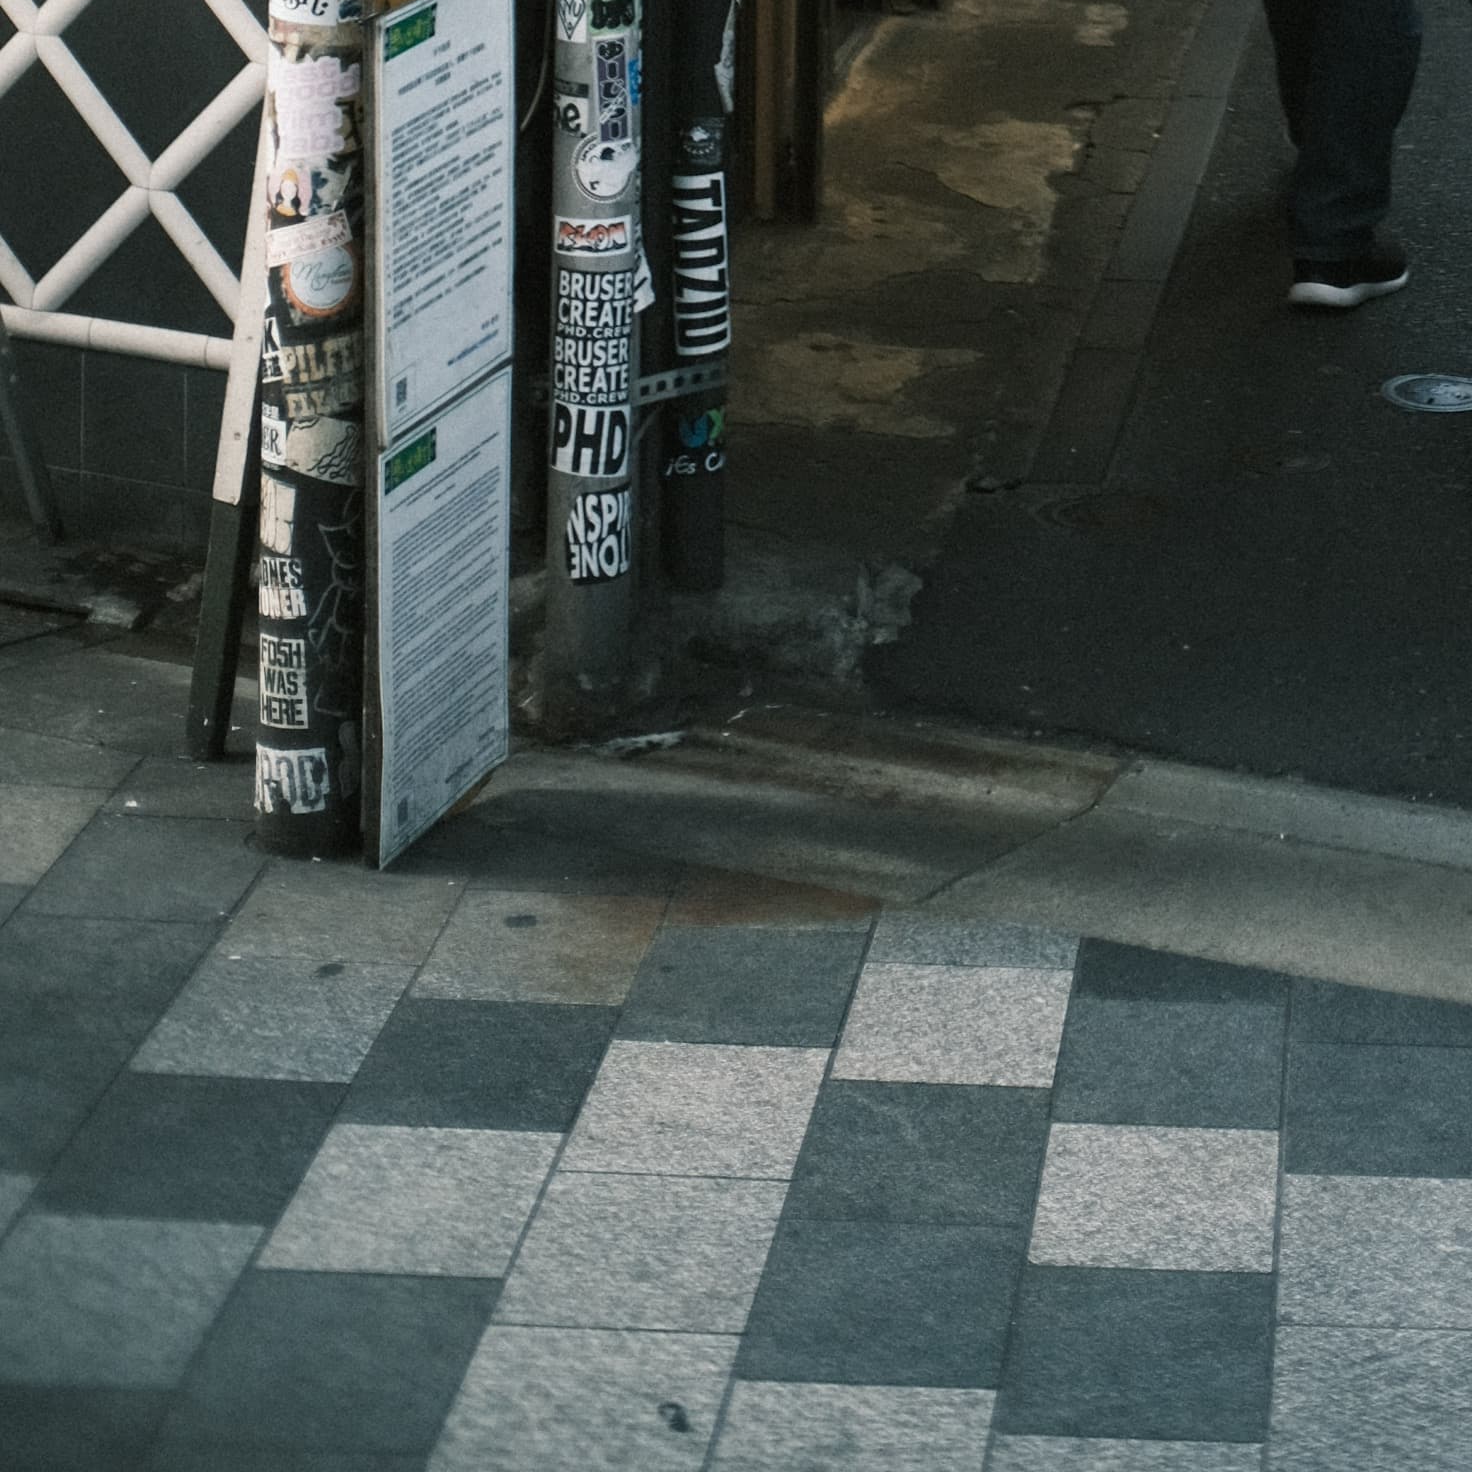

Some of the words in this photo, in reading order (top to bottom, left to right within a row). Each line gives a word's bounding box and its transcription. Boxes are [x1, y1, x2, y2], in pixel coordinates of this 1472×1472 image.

[558, 270, 633, 301] BRUSER
[556, 299, 633, 329] CREATE
[554, 336, 629, 367] BRUSER
[554, 363, 629, 393] CREATE
[551, 402, 629, 476] PHD
[263, 667, 299, 696] WAS
[260, 696, 305, 725] HERE
